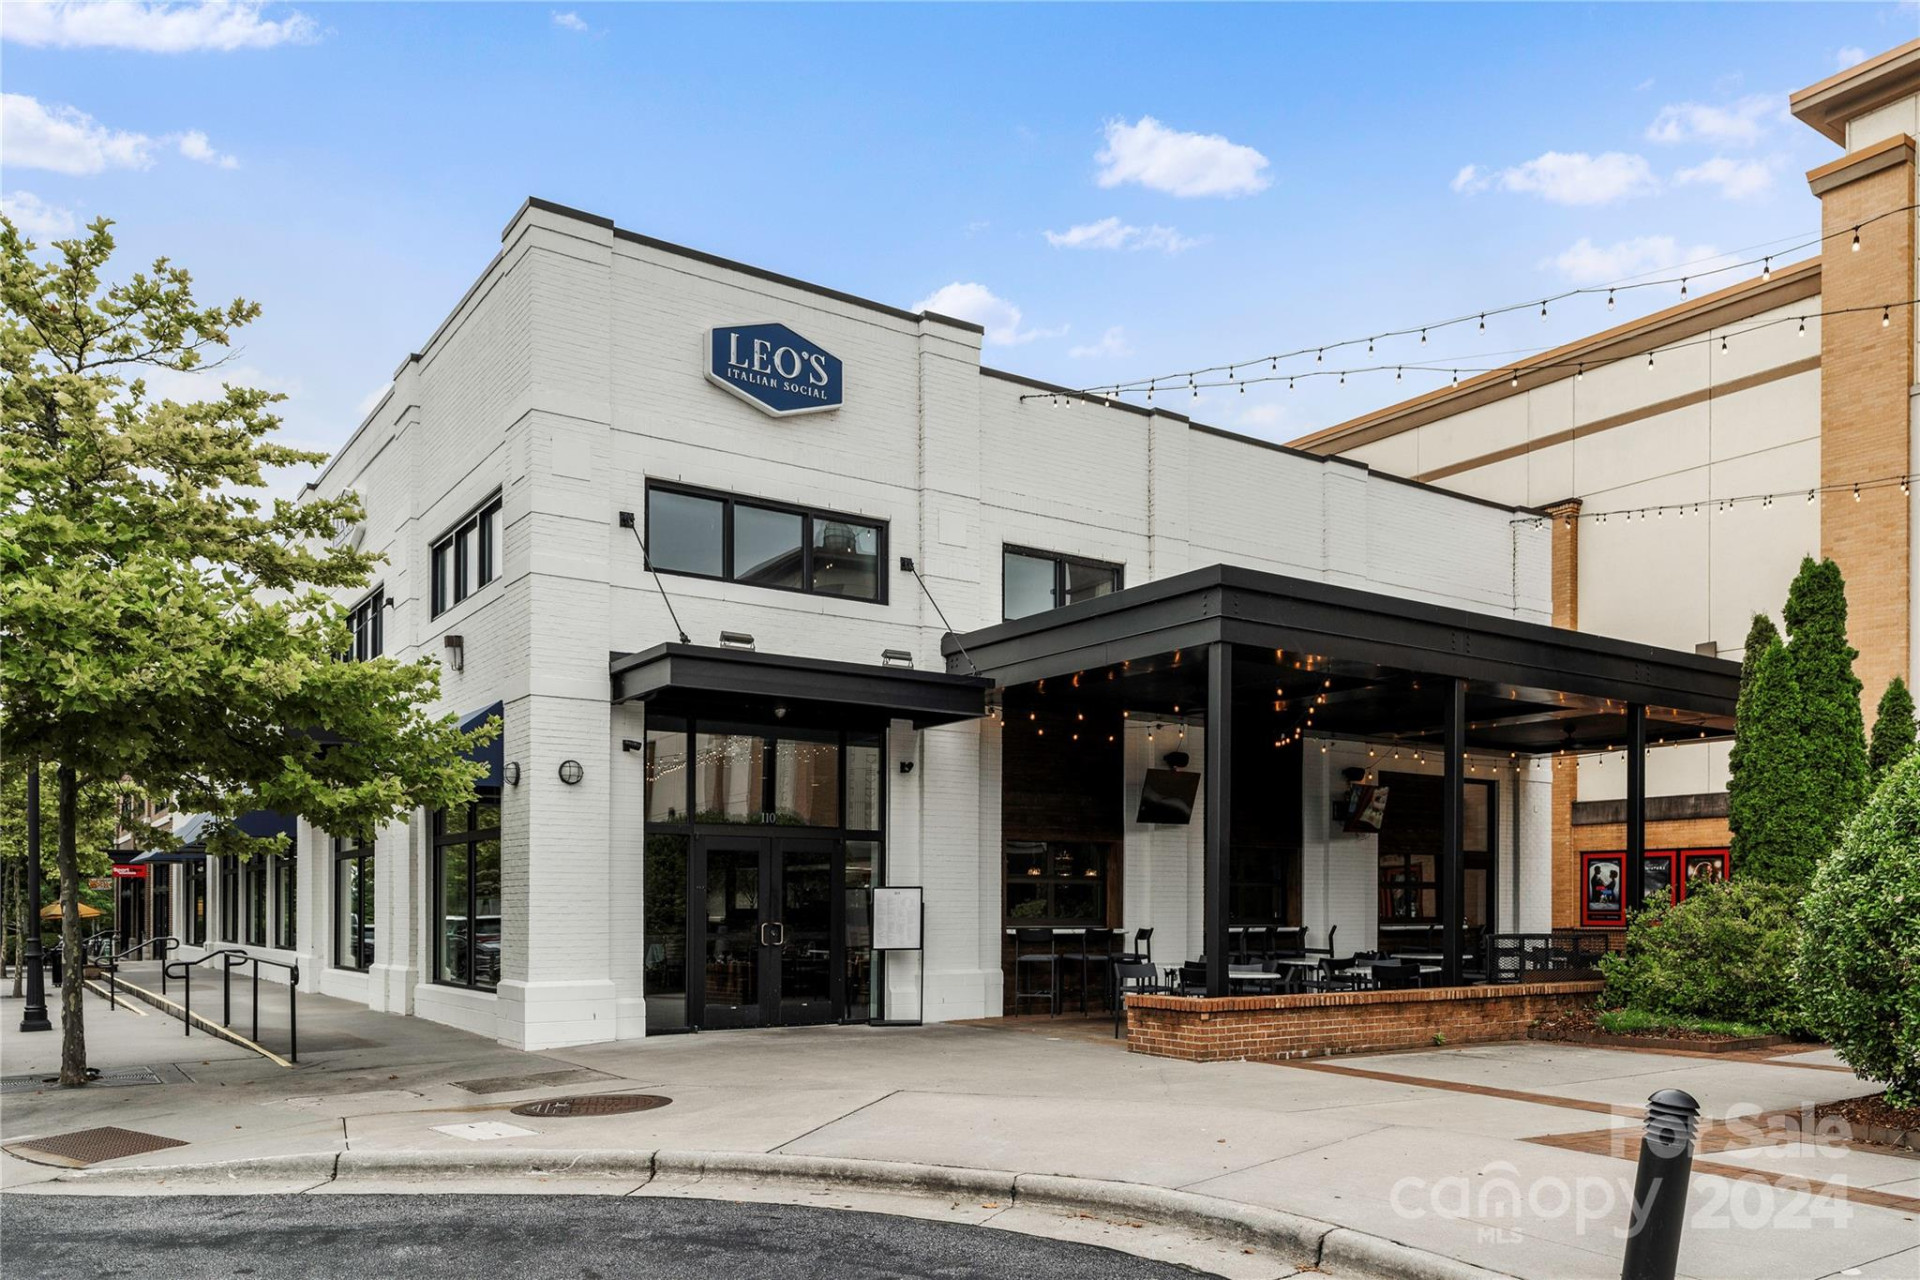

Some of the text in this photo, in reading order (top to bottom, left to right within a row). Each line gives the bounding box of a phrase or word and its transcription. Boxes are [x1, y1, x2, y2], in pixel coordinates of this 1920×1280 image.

[728, 332, 829, 387] LEO'S
[727, 367, 828, 400] ITALIAN SOCIAL
[761, 812, 776, 824] 110
